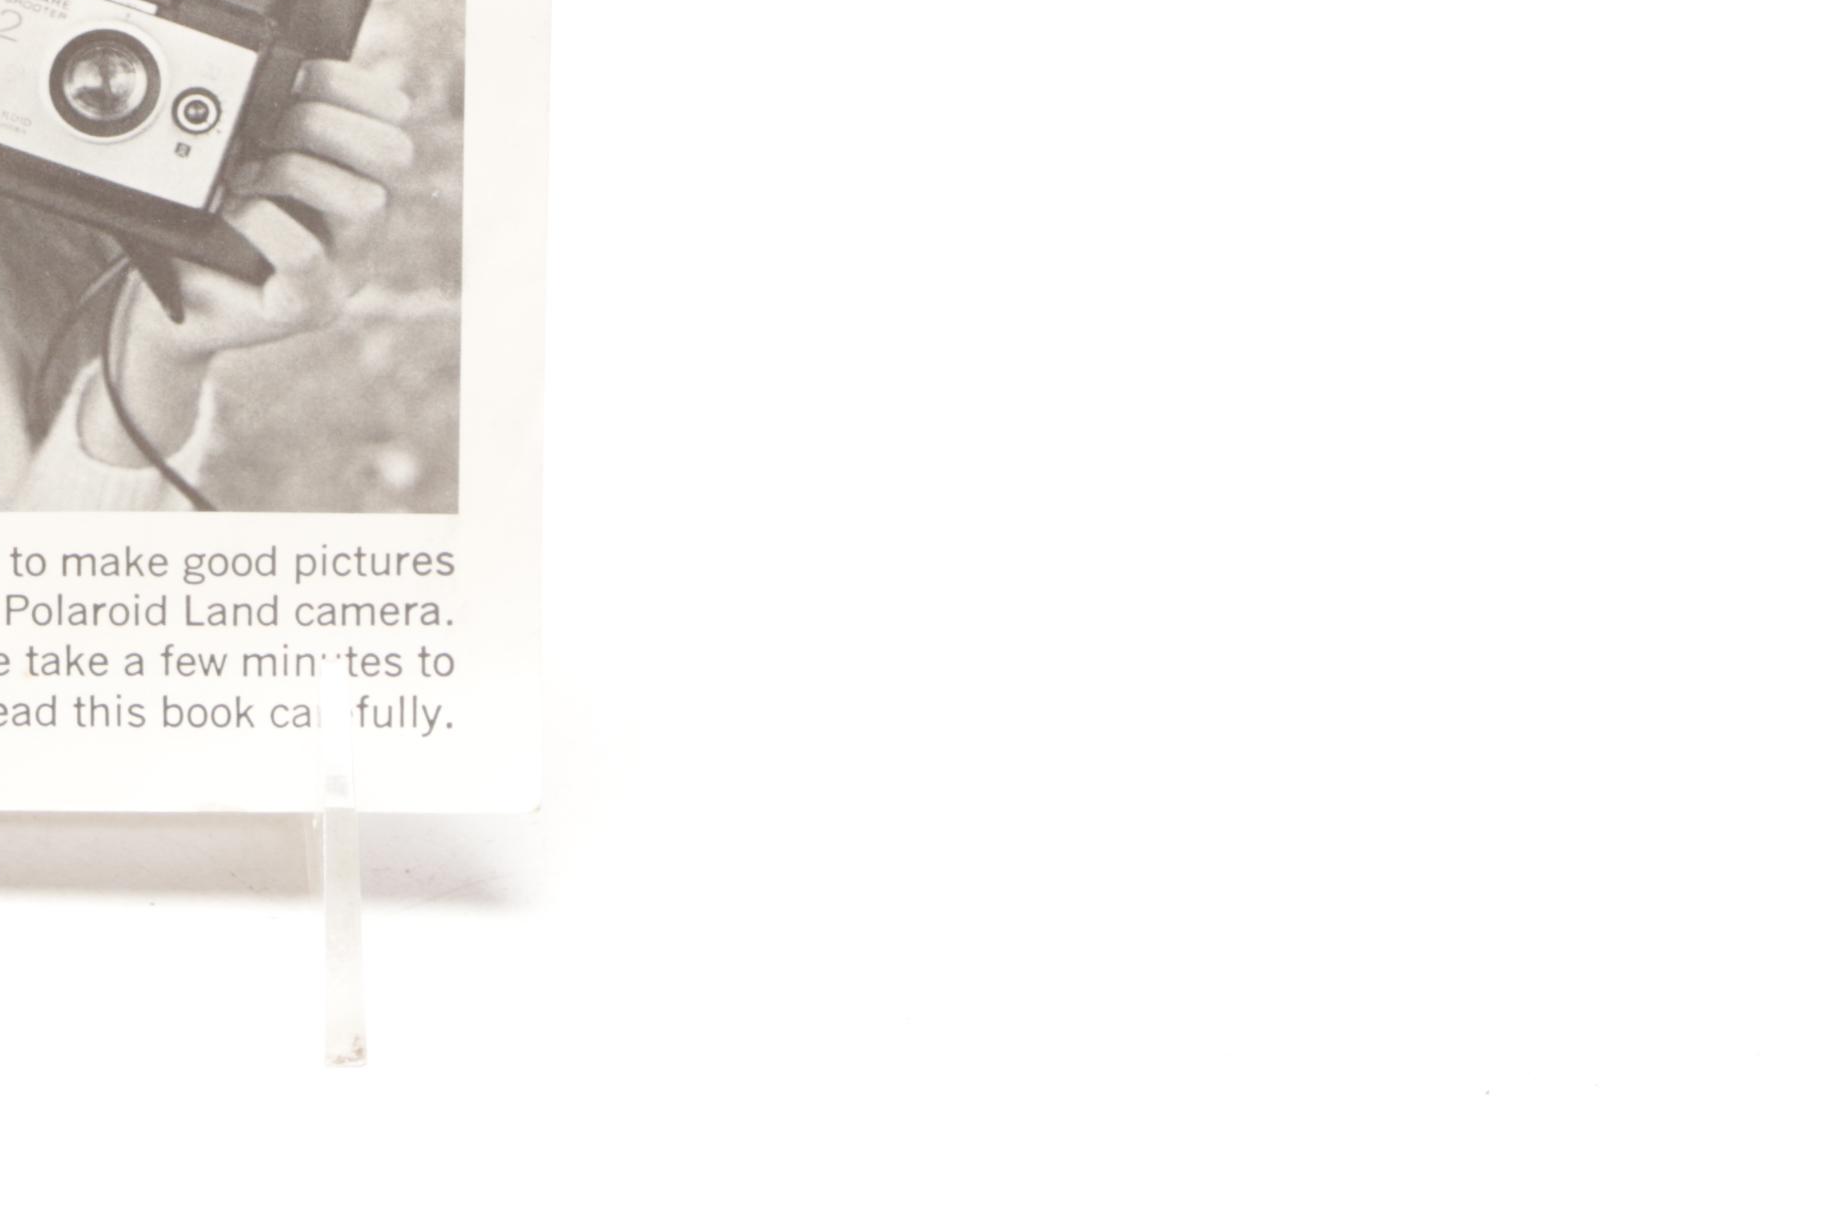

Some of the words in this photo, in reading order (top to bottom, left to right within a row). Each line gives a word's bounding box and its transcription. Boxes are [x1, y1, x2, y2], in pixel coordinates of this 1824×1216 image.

[9, 546, 47, 577] to
[62, 545, 169, 578] make
[183, 545, 277, 585] good
[295, 544, 455, 585] pictures
[5, 593, 167, 627] Polaroid
[185, 594, 278, 627] Land
[295, 601, 455, 627] camera.
[26, 643, 109, 677] take
[124, 652, 144, 677] a
[160, 643, 228, 677] few
[242, 643, 403, 678] mintes
[417, 645, 455, 678] to
[73, 694, 146, 728] this
[162, 694, 255, 729] book
[270, 694, 454, 738] cafully.
